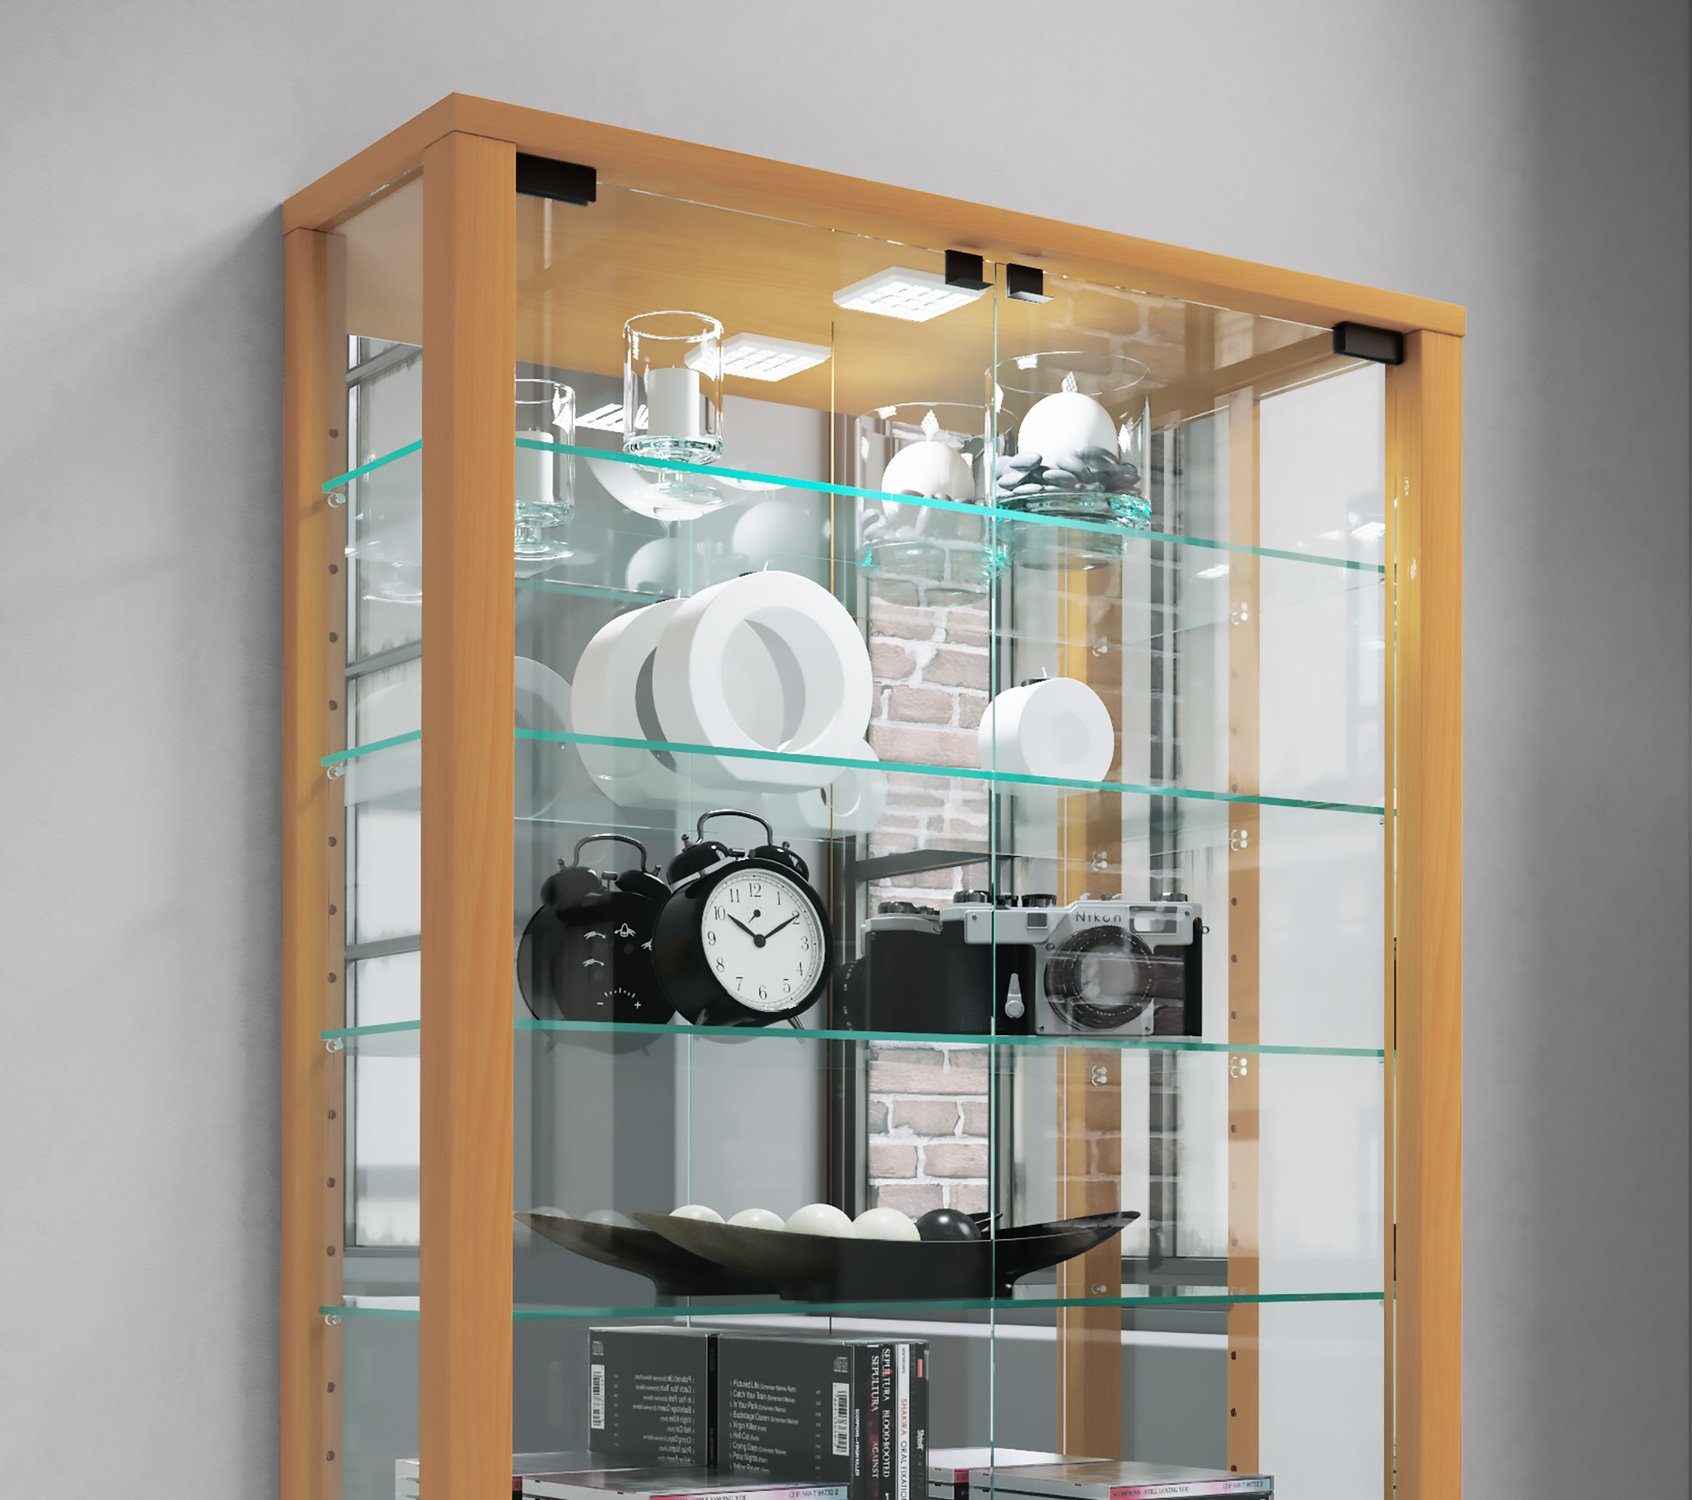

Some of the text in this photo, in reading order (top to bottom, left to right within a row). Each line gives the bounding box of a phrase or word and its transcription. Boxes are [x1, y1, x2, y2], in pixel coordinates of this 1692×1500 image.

[730, 888, 740, 903] 11
[749, 882, 761, 898] 12
[777, 891, 781, 905] 1
[714, 905, 726, 920] 10
[792, 910, 800, 925] 2
[1075, 912, 1122, 922] Nikon
[707, 931, 716, 946] 9
[801, 936, 809, 951] 3
[716, 957, 725, 972] 8
[796, 962, 803, 976] 4
[736, 976, 743, 991] 7
[783, 978, 791, 993] 5
[759, 985, 767, 1000] 6
[882, 1348, 891, 1401] SEPULTURA
[871, 1355, 879, 1412] SEPULTURA
